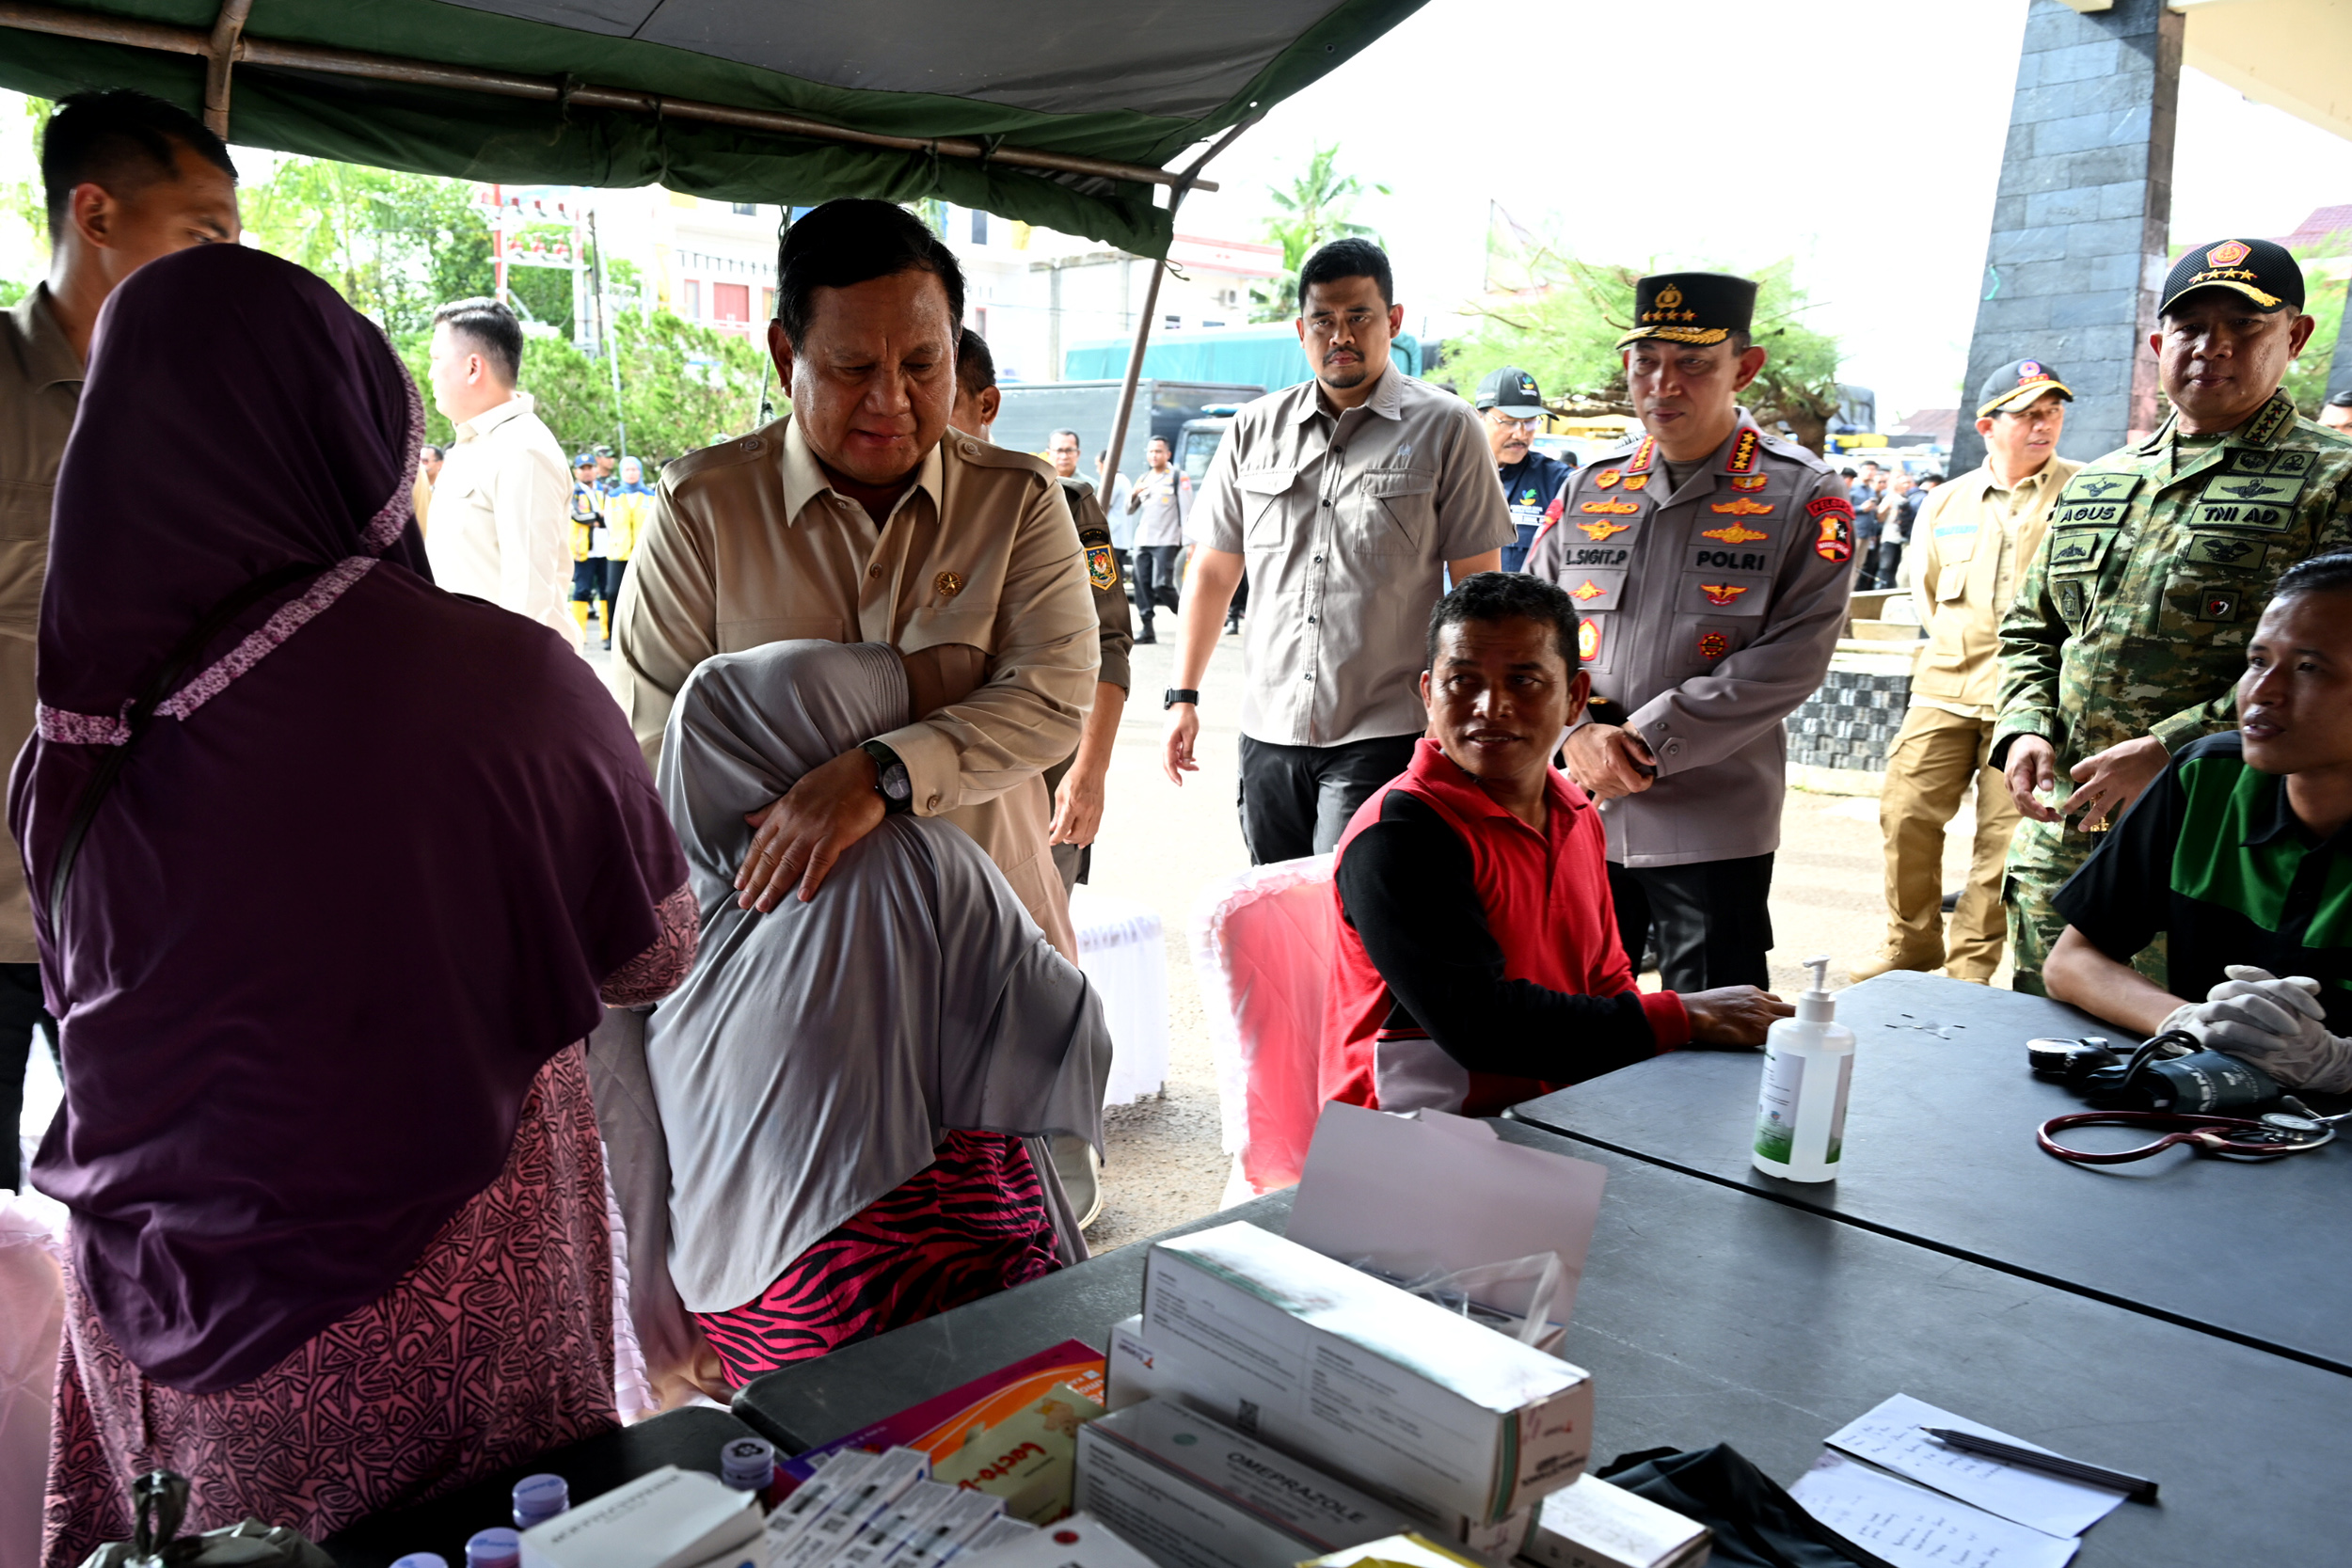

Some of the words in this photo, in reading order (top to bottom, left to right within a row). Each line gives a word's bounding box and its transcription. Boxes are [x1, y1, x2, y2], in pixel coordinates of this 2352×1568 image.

[2059, 506, 2117, 523] AGUS
[2203, 506, 2240, 521] TNI
[2241, 508, 2279, 523] AD
[1565, 549, 1628, 565] L.SIGIT.P
[1695, 550, 1766, 571] POLRI
[1226, 1451, 1367, 1524] OMEPRAZOLE
